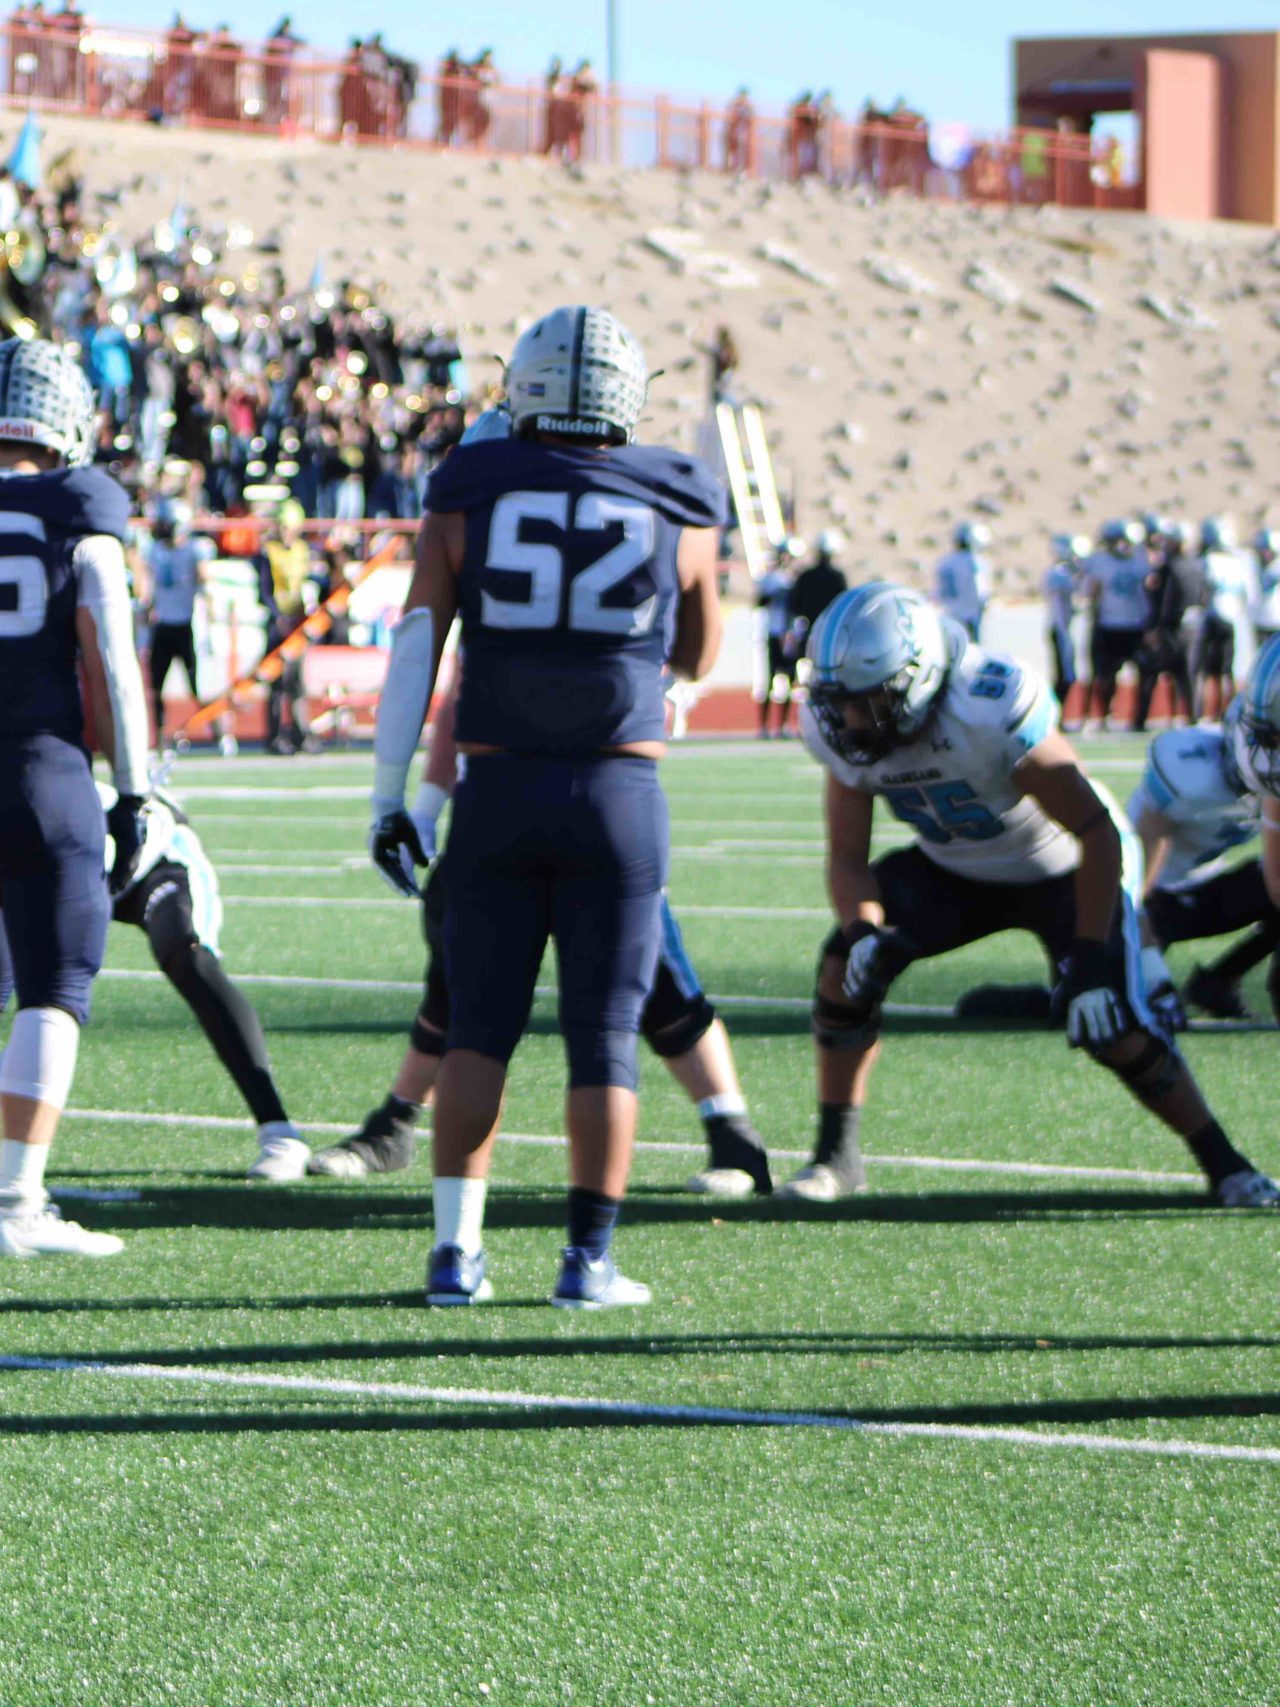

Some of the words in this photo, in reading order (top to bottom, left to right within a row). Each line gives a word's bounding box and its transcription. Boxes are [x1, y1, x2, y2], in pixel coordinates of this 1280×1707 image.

[536, 415, 609, 435] Riddell
[480, 490, 656, 637] 52
[880, 778, 1006, 844] 55
